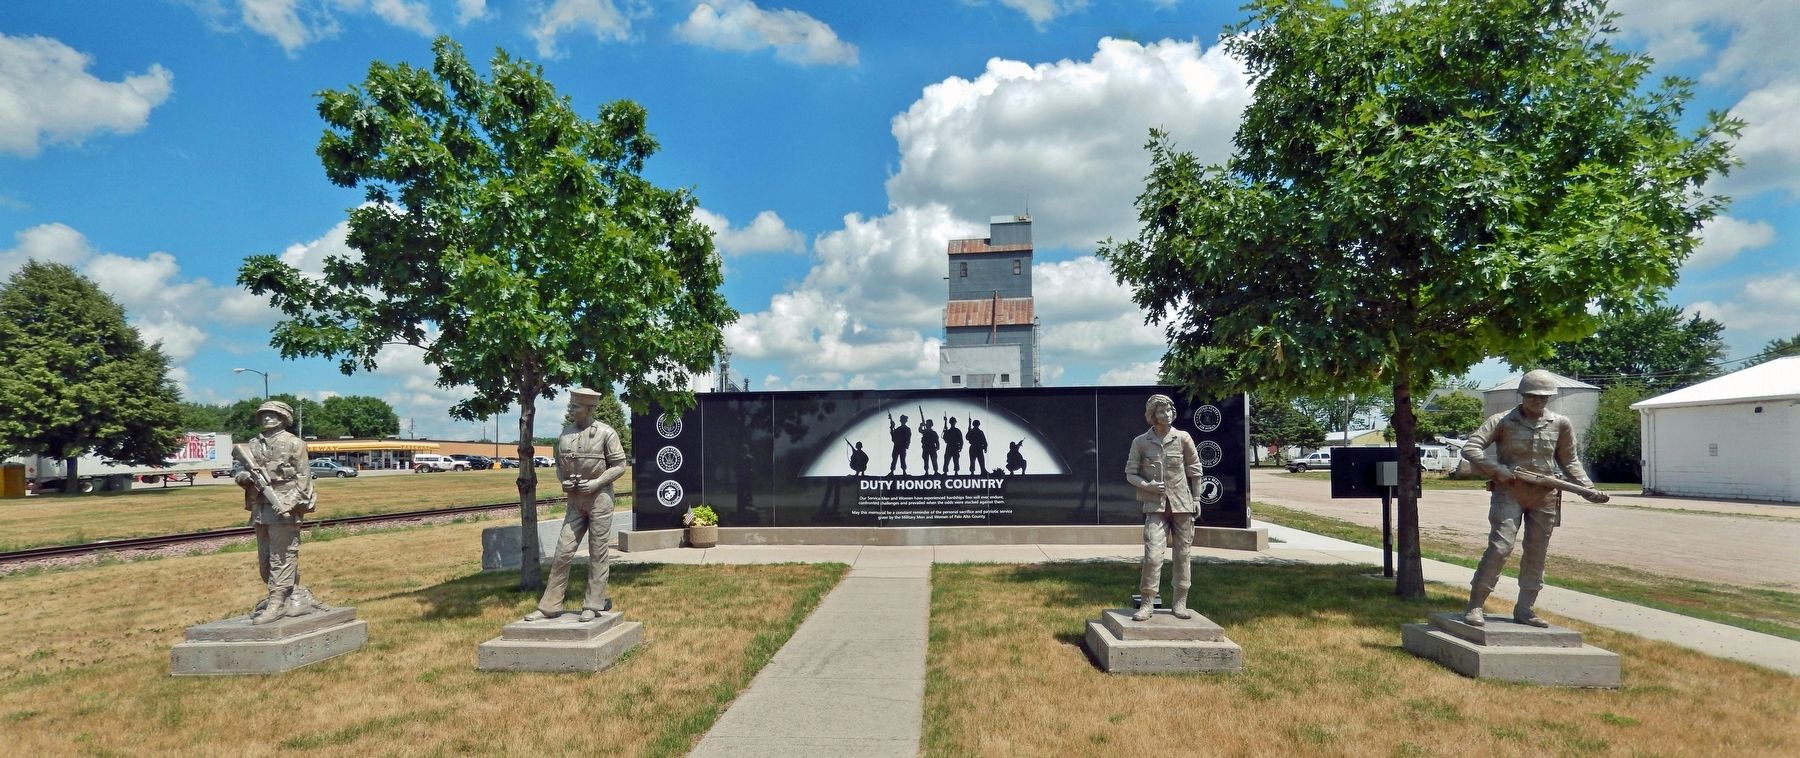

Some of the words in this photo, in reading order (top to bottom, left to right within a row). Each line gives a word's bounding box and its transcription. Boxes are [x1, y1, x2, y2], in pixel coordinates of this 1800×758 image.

[860, 480, 893, 490] DUTY
[896, 480, 941, 489] HONOR
[945, 479, 1004, 489] COUNTRY
